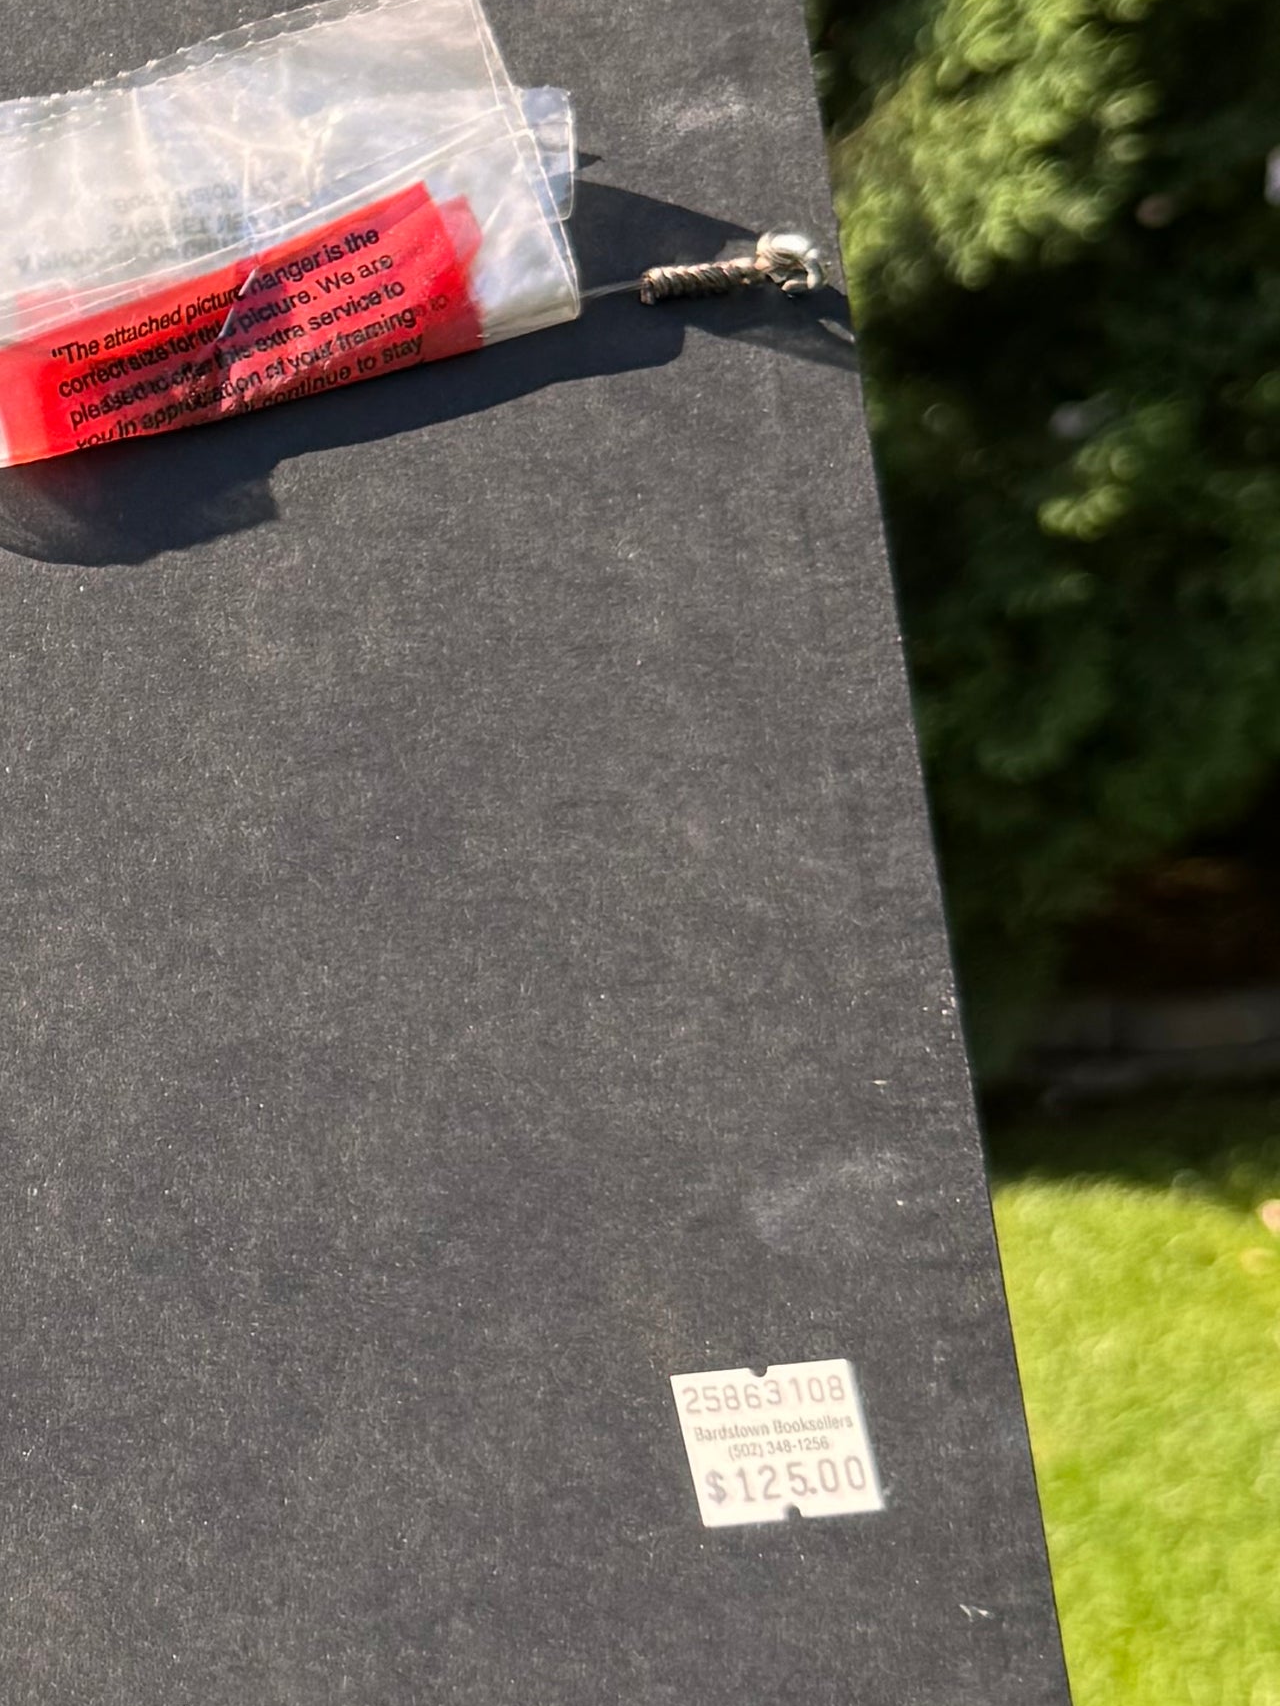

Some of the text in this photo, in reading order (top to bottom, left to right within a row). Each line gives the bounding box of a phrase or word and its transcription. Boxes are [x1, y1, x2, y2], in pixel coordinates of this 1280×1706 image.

[103, 304, 181, 351] attached
[323, 243, 344, 264] is
[344, 229, 380, 254] the
[58, 357, 128, 398] correct
[129, 346, 169, 371] size
[167, 332, 197, 355] for
[238, 289, 317, 333] picture.
[316, 271, 355, 295] We
[357, 255, 394, 278] are
[70, 381, 149, 431] pleased
[255, 324, 304, 352] extra
[310, 289, 382, 332] service
[383, 279, 405, 299] to
[116, 419, 138, 438] in
[337, 309, 417, 351] framing
[357, 356, 377, 374] to
[382, 333, 424, 364] stay
[682, 1374, 846, 1414] 25863108
[693, 1421, 770, 1442] Bardstown
[727, 1436, 830, 1461] (502) 348-1256
[705, 1455, 867, 1505] $125.00
